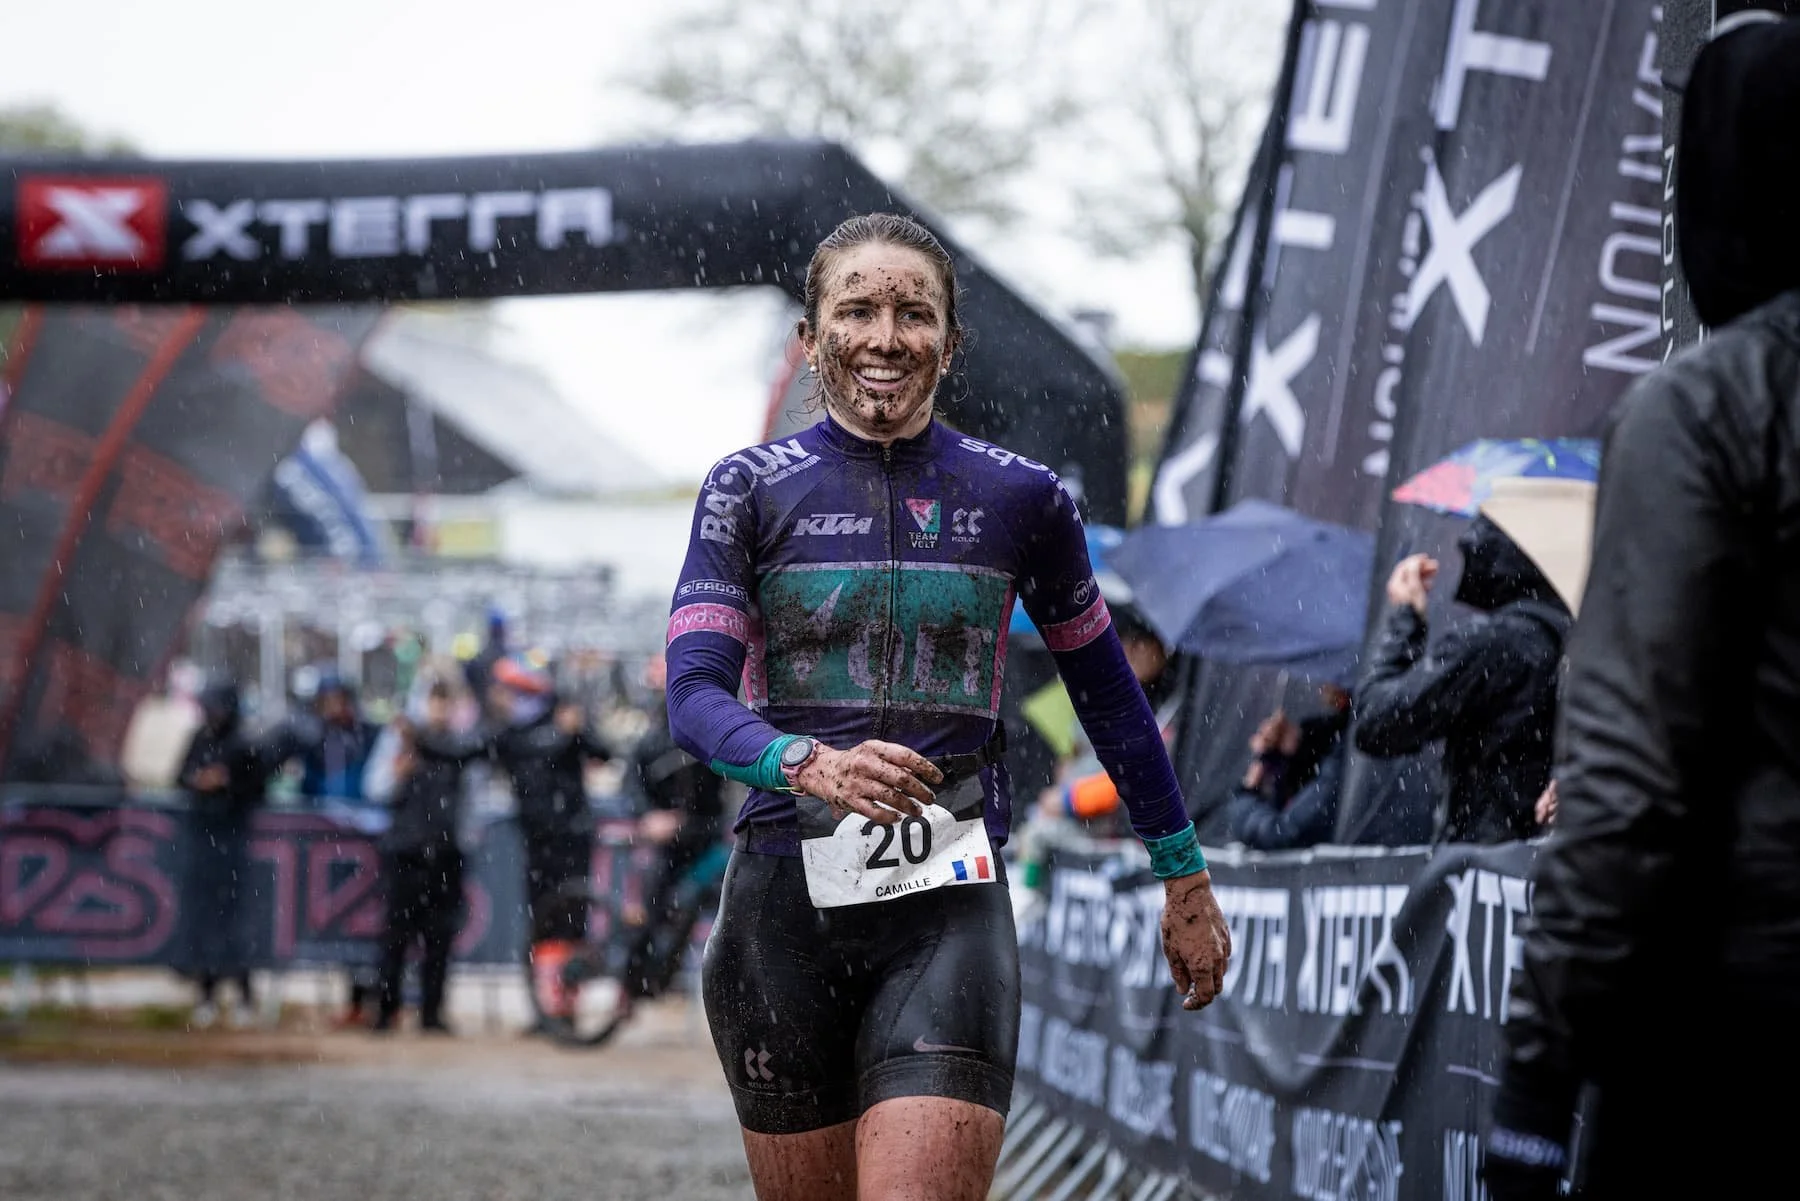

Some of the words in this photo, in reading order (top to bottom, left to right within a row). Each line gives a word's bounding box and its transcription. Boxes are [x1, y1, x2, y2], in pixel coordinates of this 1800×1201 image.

[179, 187, 614, 262] XTERRA
[1240, 0, 1378, 458] XTE
[791, 513, 873, 537] KTM
[908, 531, 938, 541] TEAM
[911, 541, 936, 549] VOLT
[673, 608, 749, 639] Hydrati
[860, 814, 933, 871] 20
[875, 877, 932, 898] CAMILLE
[1445, 868, 1536, 1026] XTE
